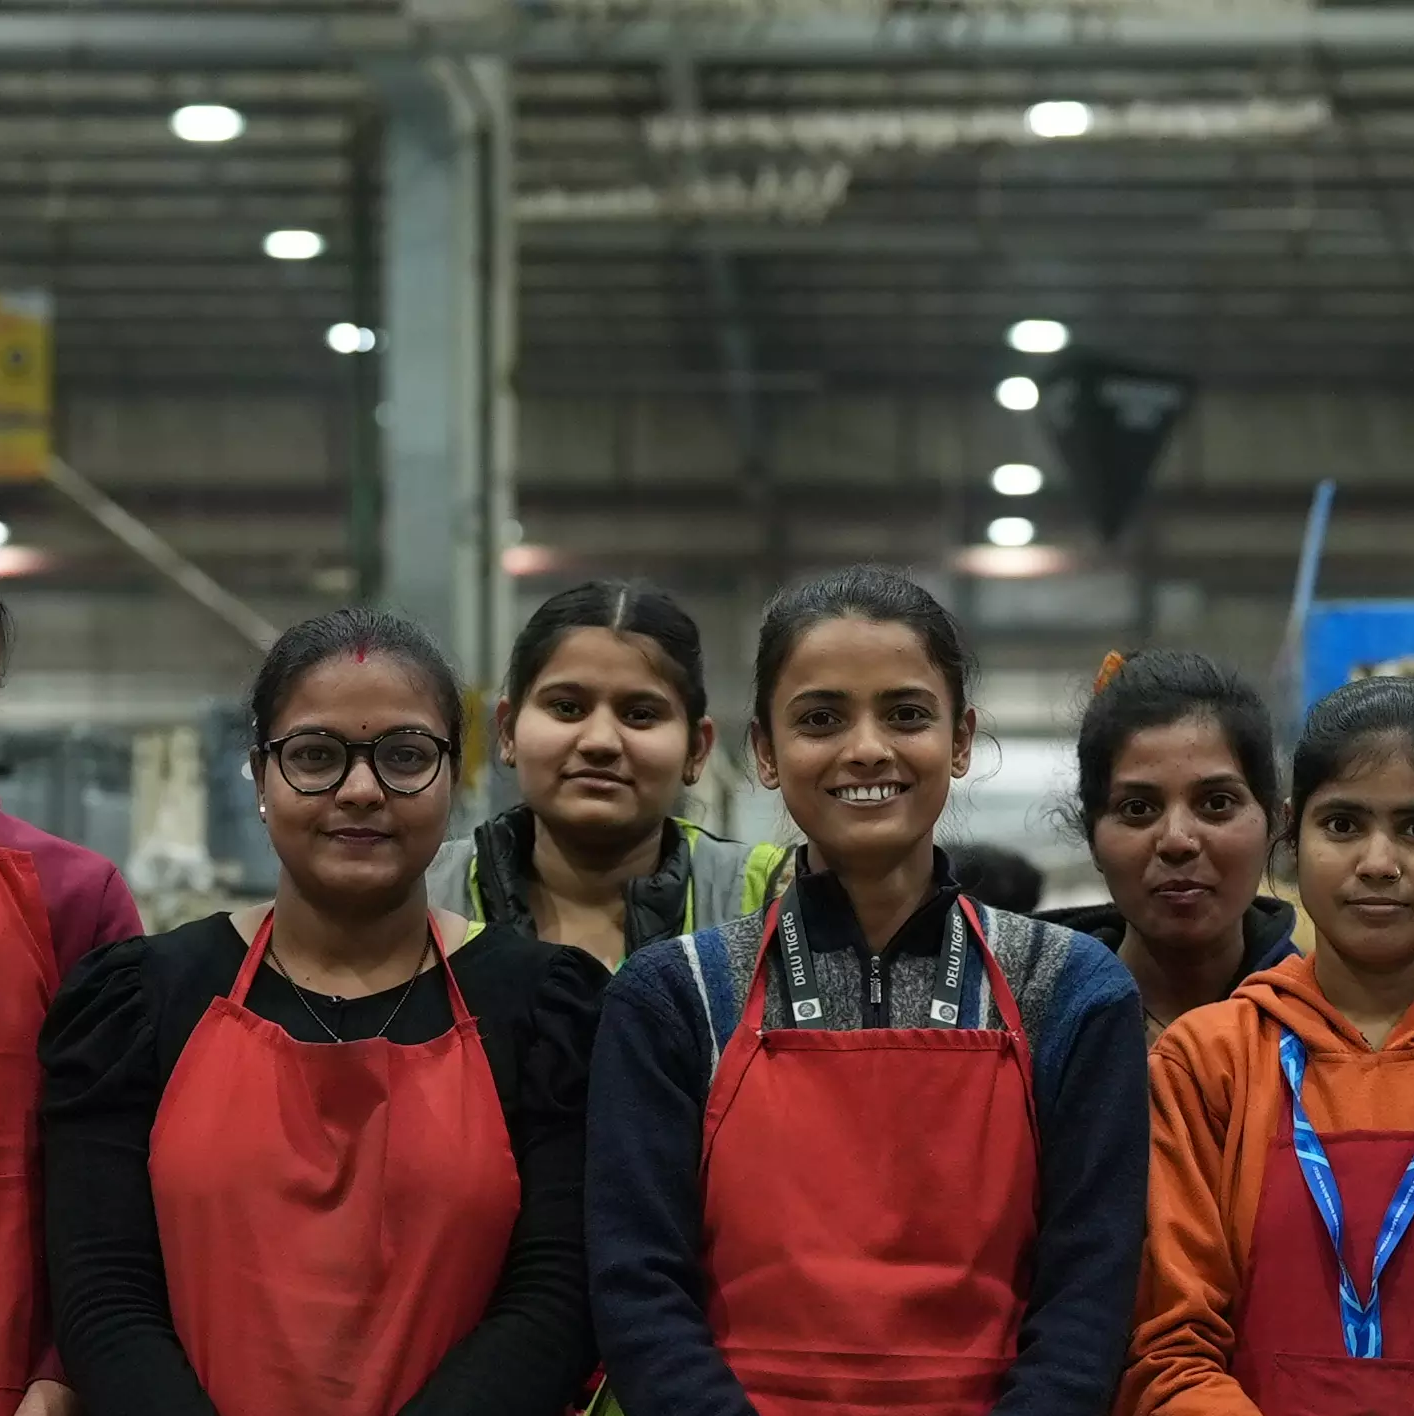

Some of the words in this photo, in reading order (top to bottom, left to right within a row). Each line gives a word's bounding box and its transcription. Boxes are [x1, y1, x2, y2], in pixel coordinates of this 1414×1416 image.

[782, 911, 800, 955] TIGERS
[950, 913, 965, 956] TIGERS
[789, 955, 806, 987] DELU
[946, 956, 961, 989] DELU
